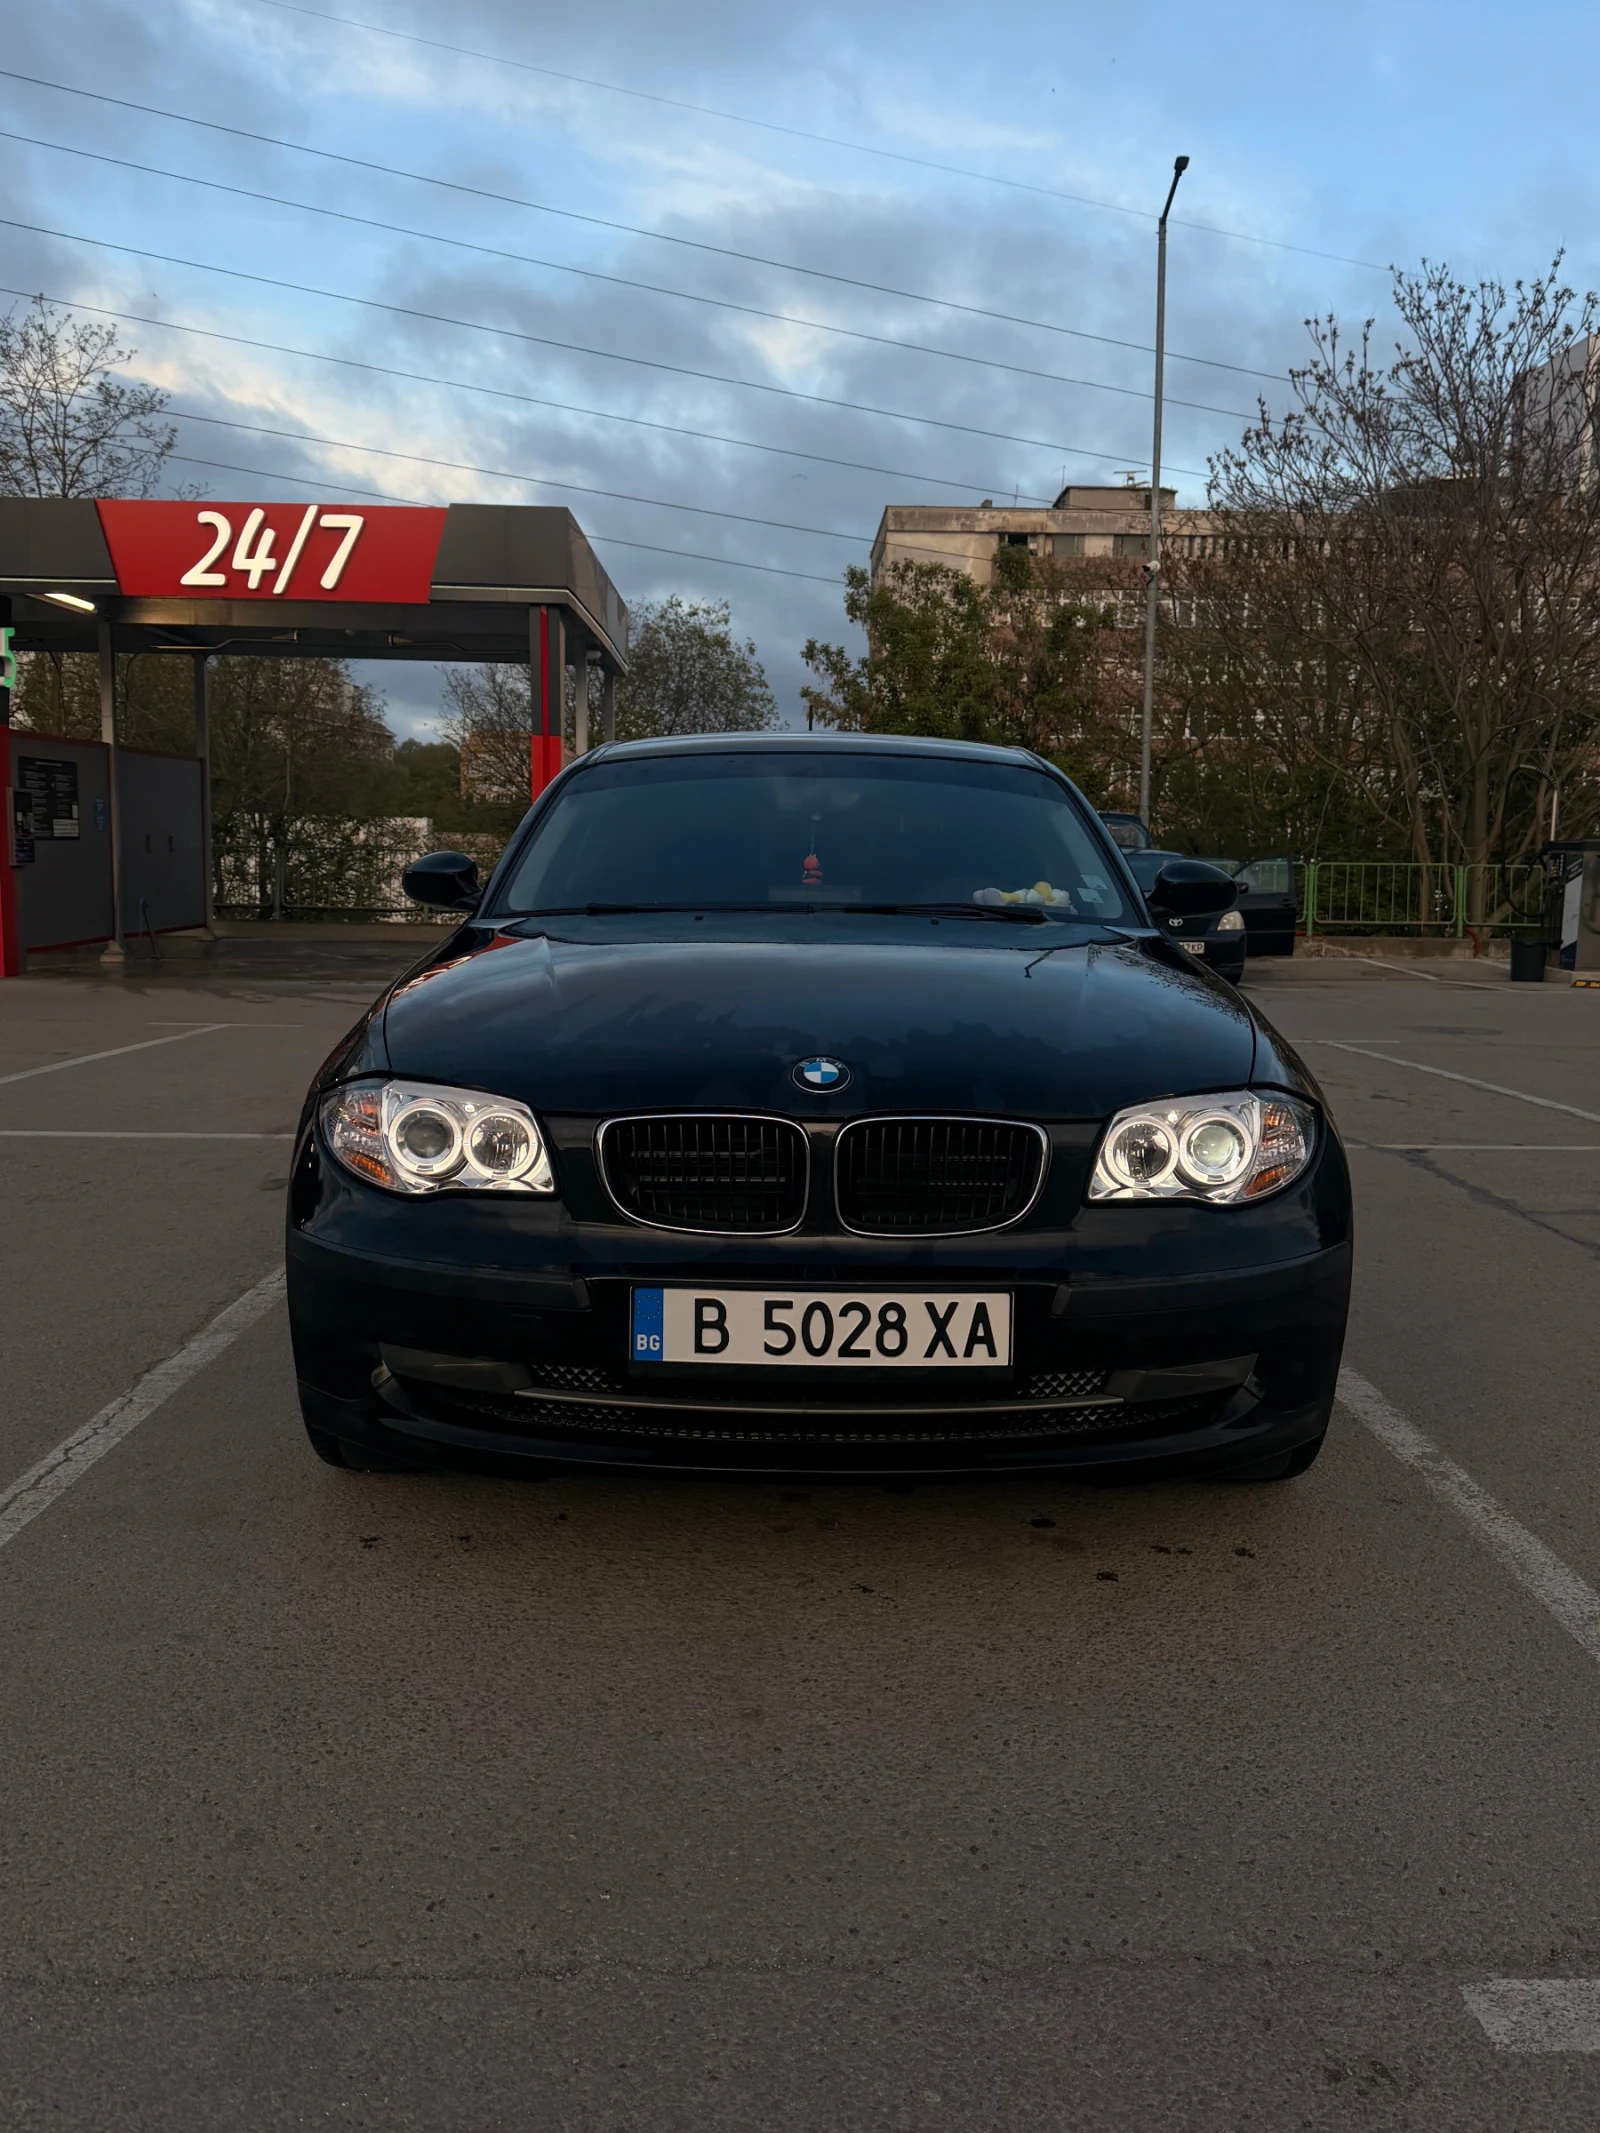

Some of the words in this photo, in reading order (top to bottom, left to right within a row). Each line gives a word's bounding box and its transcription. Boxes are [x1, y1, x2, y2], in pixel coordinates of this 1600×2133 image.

[180, 505, 364, 594] 24/7
[636, 1335, 660, 1351] BG
[694, 1298, 730, 1354] B
[763, 1300, 908, 1357] 5028
[923, 1301, 998, 1358] XA
